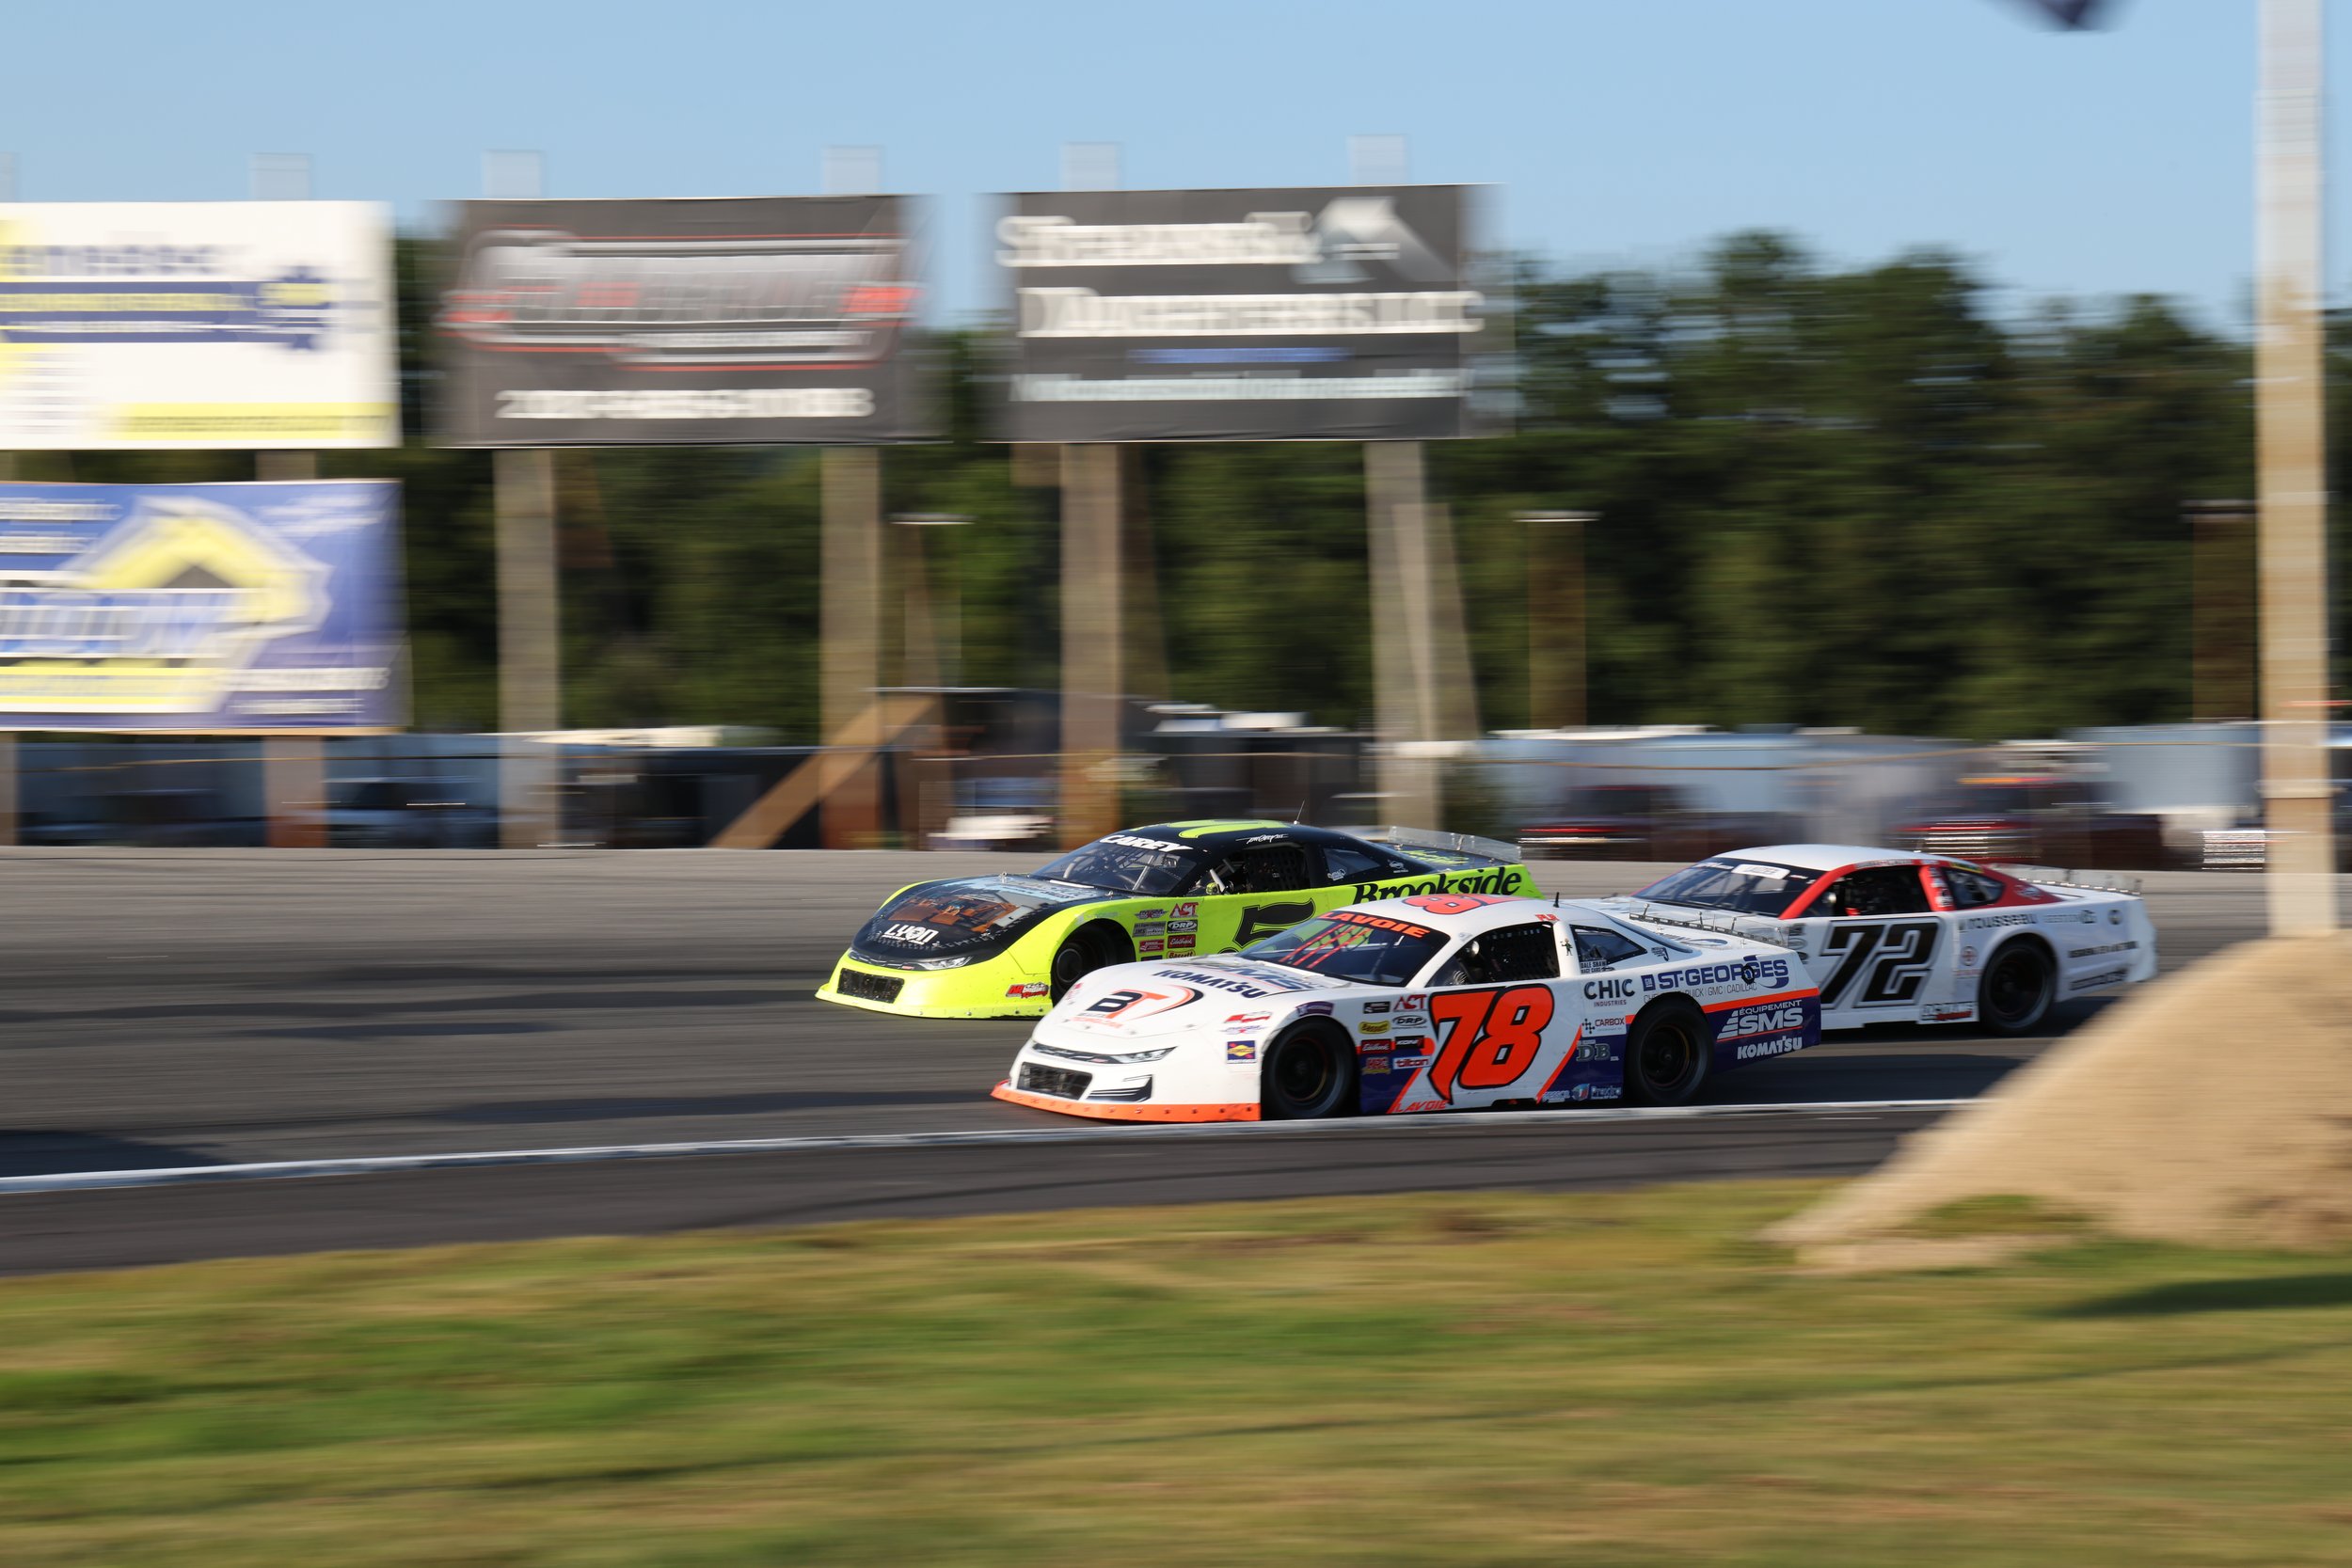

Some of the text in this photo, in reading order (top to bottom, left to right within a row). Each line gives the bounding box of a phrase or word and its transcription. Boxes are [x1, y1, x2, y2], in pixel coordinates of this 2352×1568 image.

[1352, 865, 1522, 906] Brookside
[882, 924, 939, 945] LYON
[1316, 911, 1431, 939] LAVOIE
[1820, 917, 1942, 1009] 72
[1151, 969, 1269, 999] KOMATSU
[1583, 978, 1635, 1000] CHIC
[1708, 986, 1724, 996] GMC
[1393, 994, 1427, 1010] ACT
[1594, 999, 1627, 1007] INDUSTRIES
[1739, 999, 1803, 1016] ÉQUIPEMENT
[1595, 1018, 1625, 1026] CARBOX
[1738, 1007, 1804, 1035] SMS
[1427, 983, 1555, 1105] 78
[1576, 1043, 1611, 1061] DB
[1737, 1036, 1803, 1060] KOMATSU
[1393, 1100, 1449, 1113] LAVOIE
